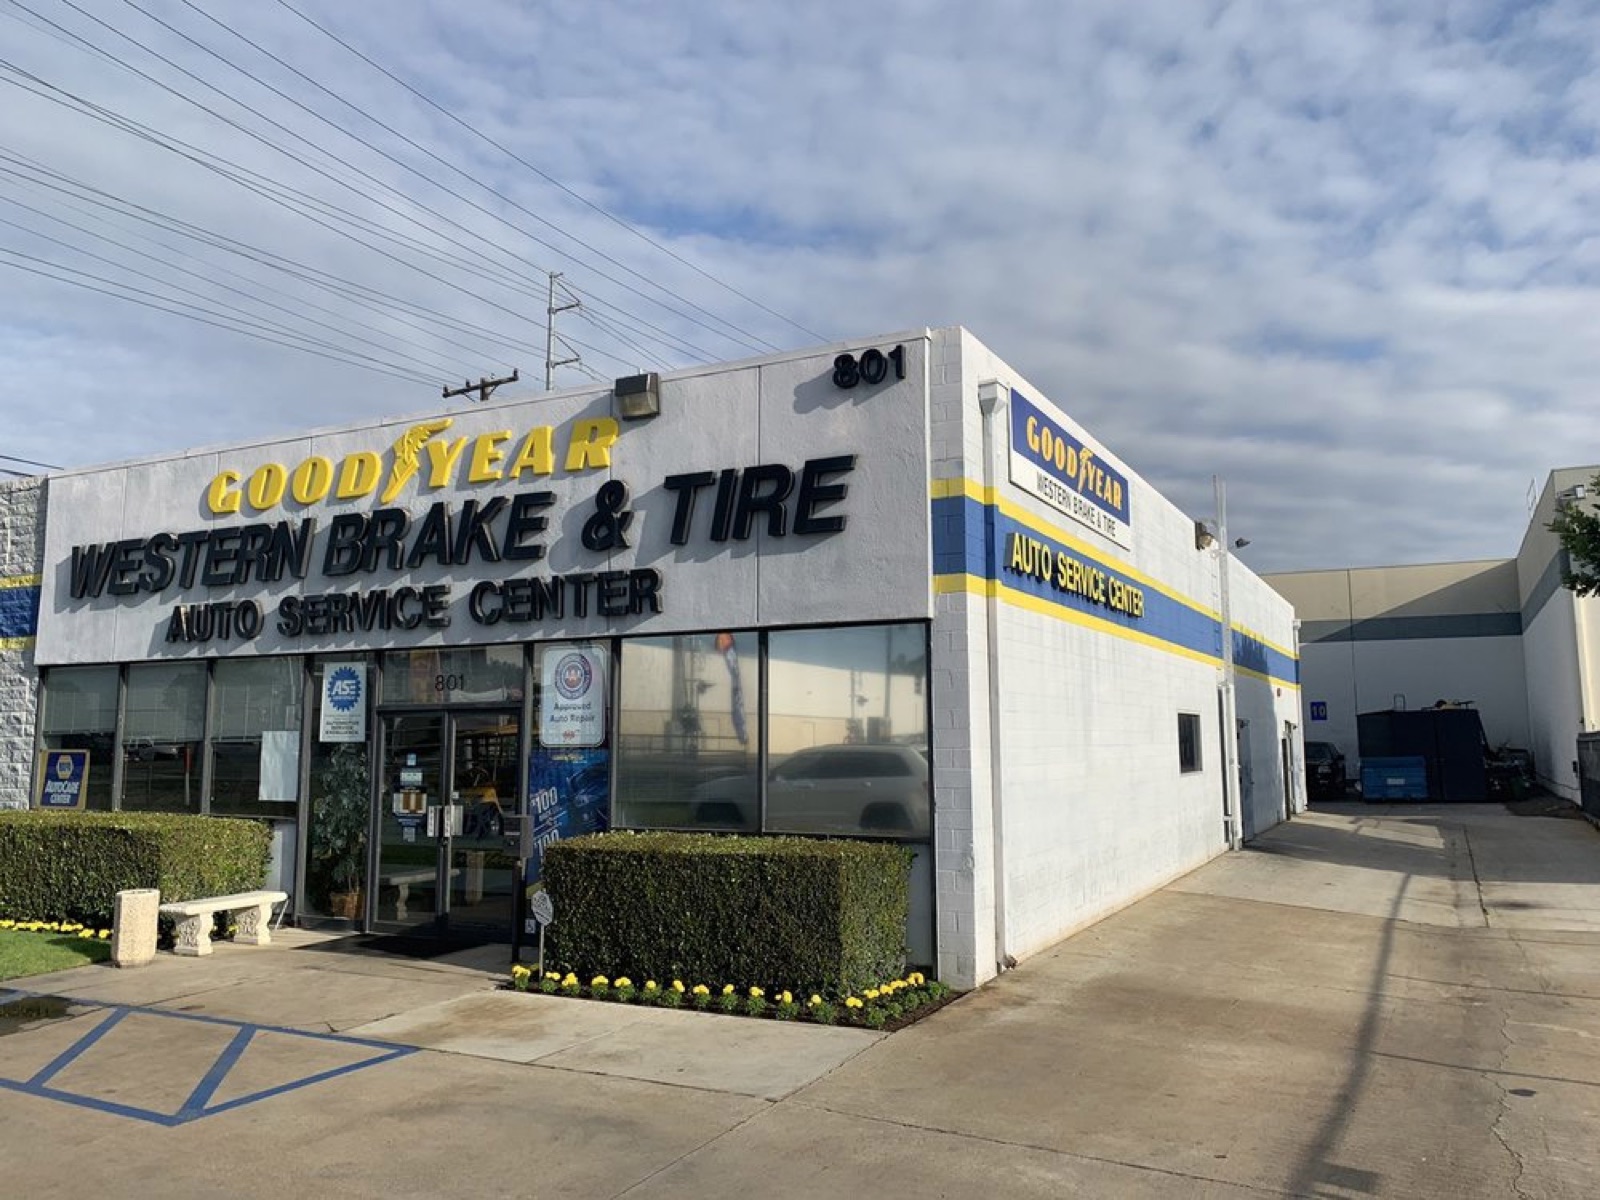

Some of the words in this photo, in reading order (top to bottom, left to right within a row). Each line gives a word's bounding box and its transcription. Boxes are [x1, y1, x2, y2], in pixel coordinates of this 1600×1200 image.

[831, 344, 906, 389] 801
[207, 417, 619, 513] GOODYEAR
[1026, 415, 1122, 511] GOODYEAR
[70, 517, 317, 599] WESTERN
[322, 490, 557, 576] BRAKE
[581, 479, 635, 552] &
[663, 454, 858, 546] TIRE
[1036, 471, 1071, 512] WESTERN
[1073, 494, 1095, 526] BRAKE
[1103, 512, 1116, 538] TIRE
[1007, 532, 1052, 583] AUTO
[1056, 551, 1106, 604] SERVICE
[1108, 576, 1145, 618] CENTER
[165, 599, 265, 643] AUTO
[277, 585, 451, 637] SERVICE
[468, 568, 664, 626] CENTER
[332, 679, 356, 695] ASE
[435, 673, 464, 691] 801
[553, 702, 592, 712] Approved
[550, 714, 569, 722] Auto
[1312, 705, 1327, 717] 10
